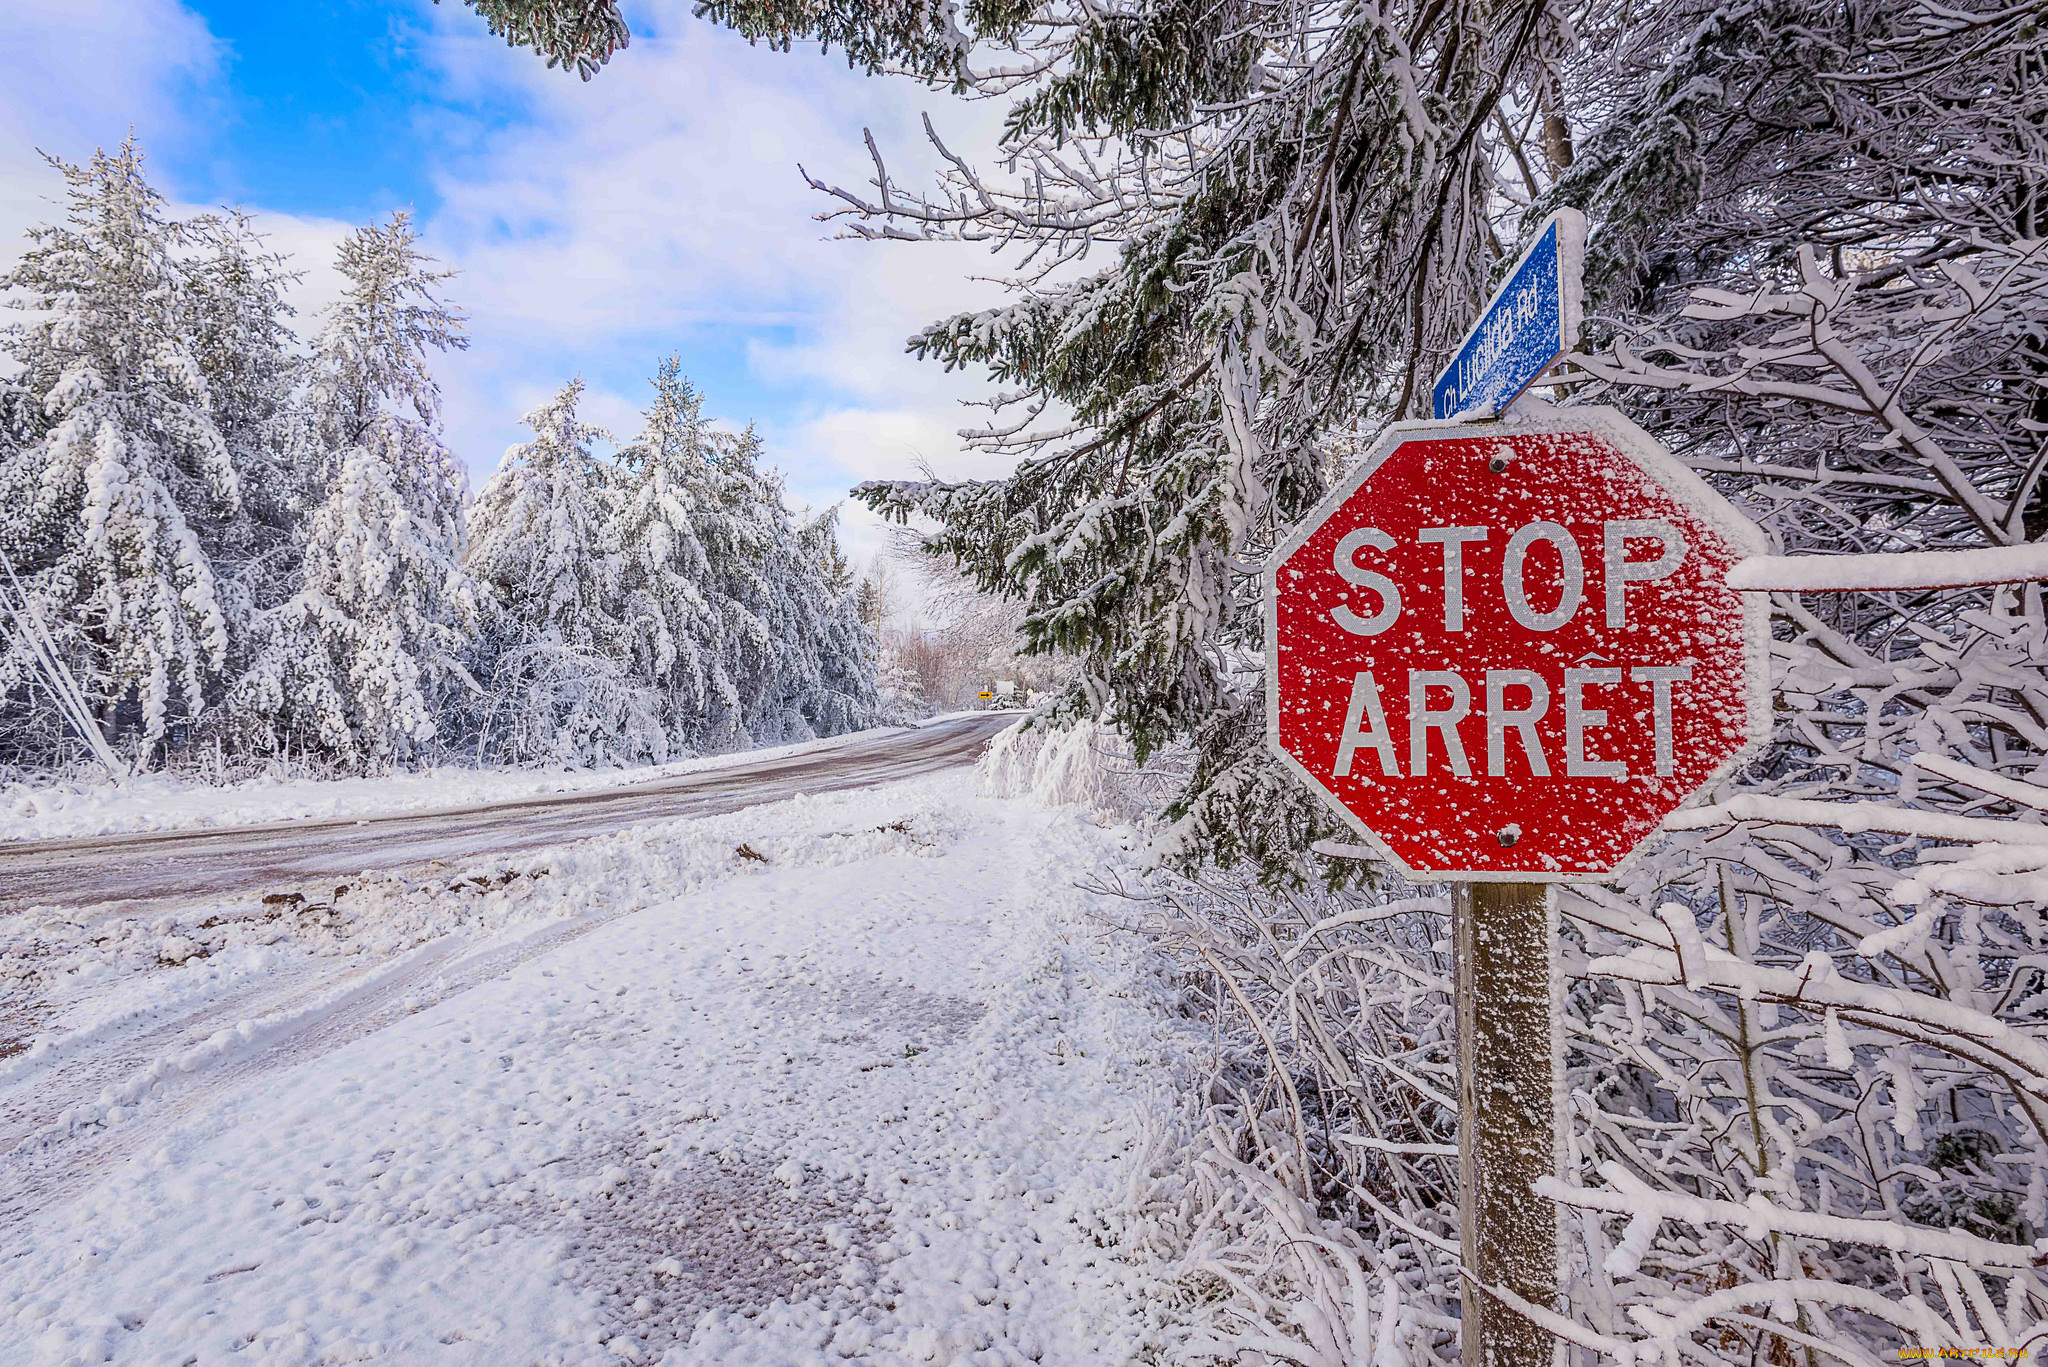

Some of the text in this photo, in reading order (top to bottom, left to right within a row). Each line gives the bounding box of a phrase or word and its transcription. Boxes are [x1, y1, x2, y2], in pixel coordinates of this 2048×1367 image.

[1517, 274, 1538, 334] Rd
[1330, 519, 1687, 636] STOP
[1332, 651, 1693, 778] ARRÊT
